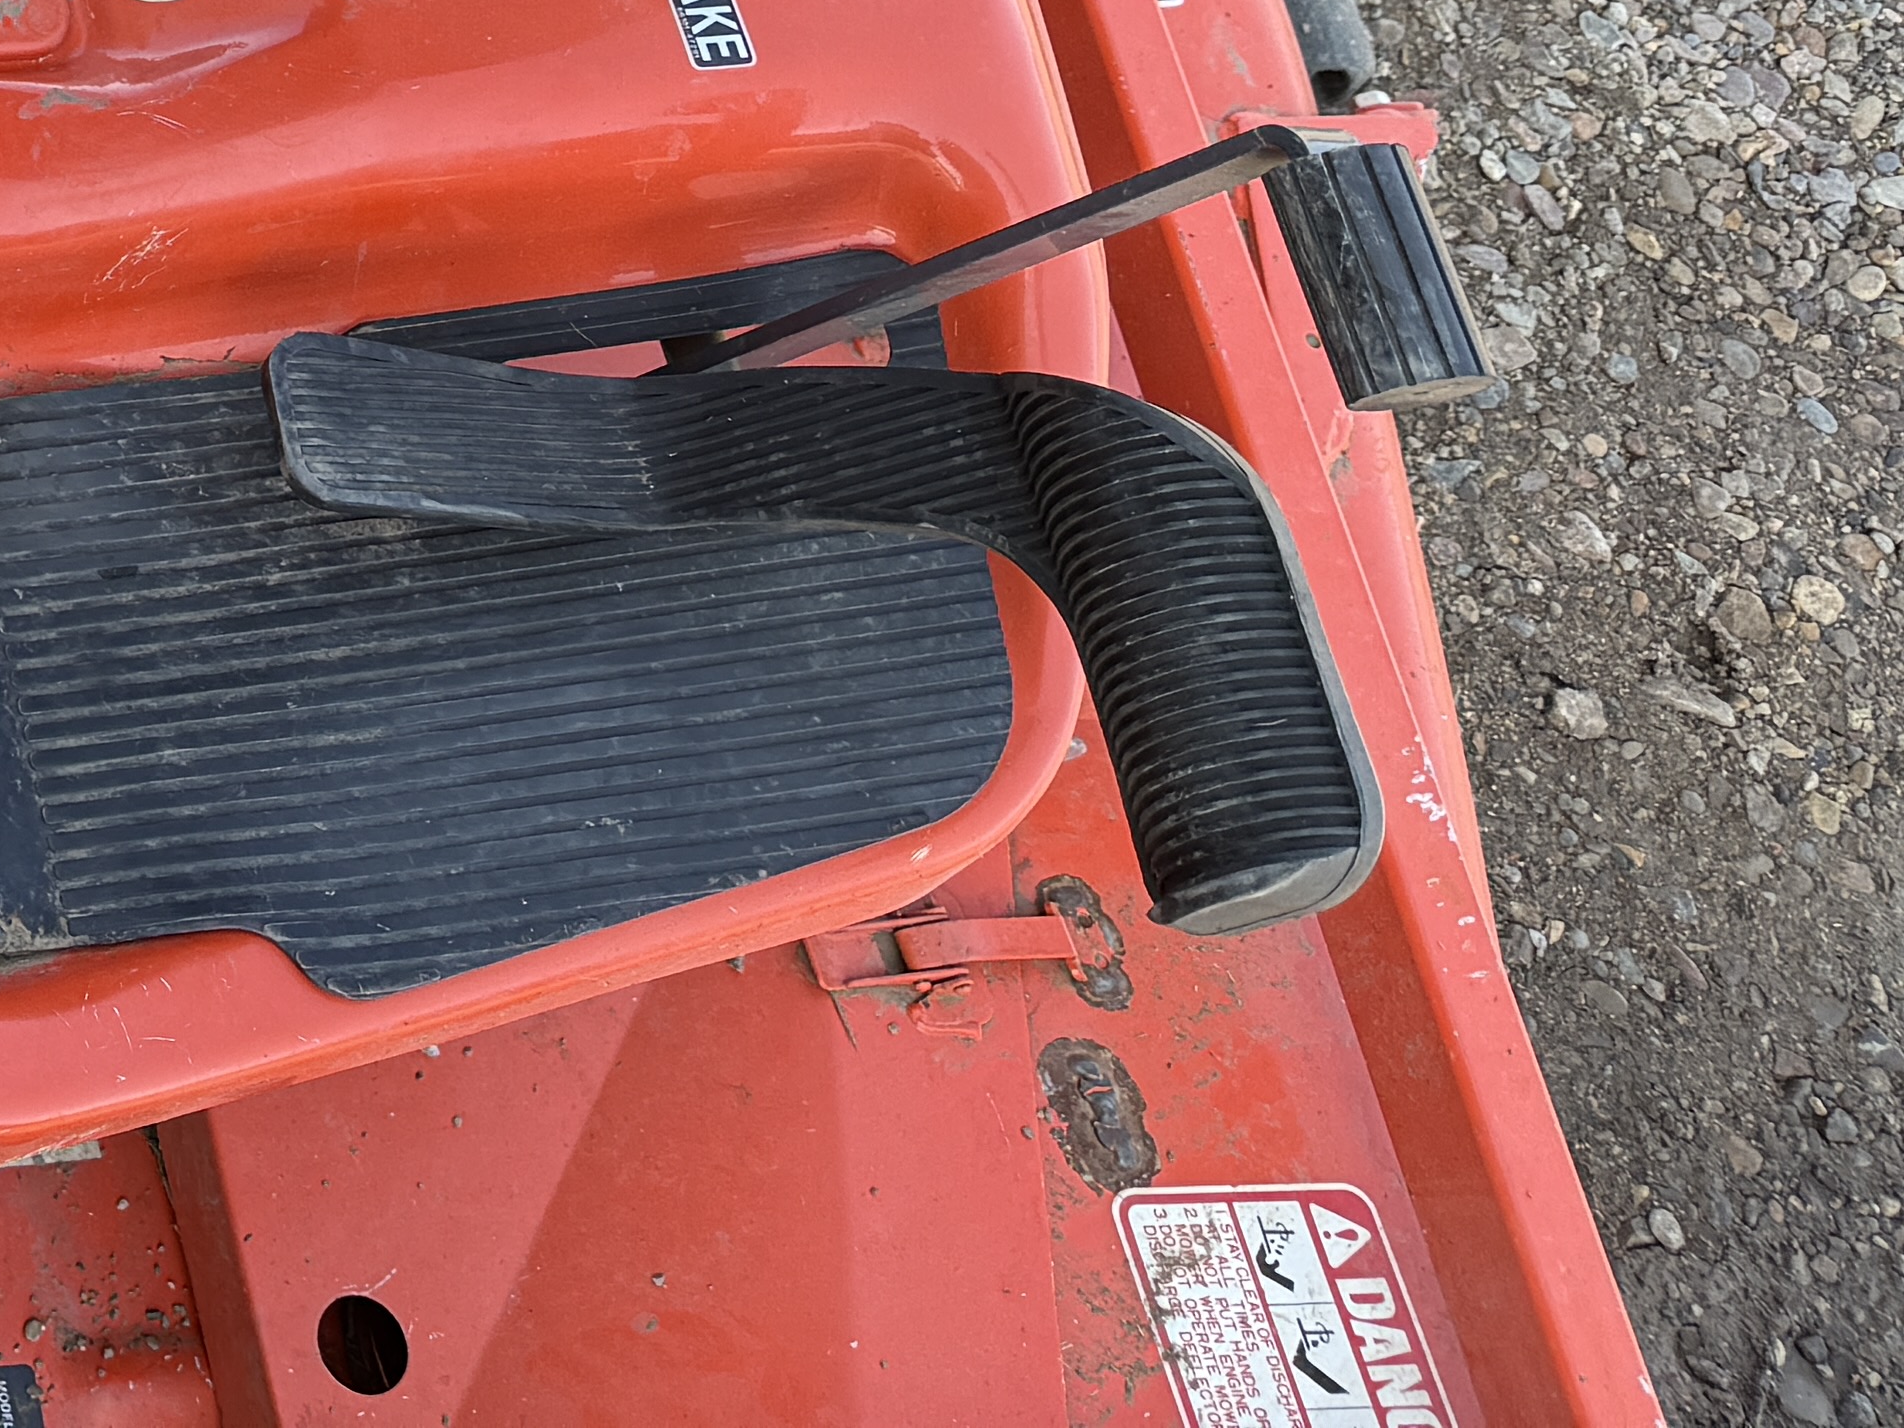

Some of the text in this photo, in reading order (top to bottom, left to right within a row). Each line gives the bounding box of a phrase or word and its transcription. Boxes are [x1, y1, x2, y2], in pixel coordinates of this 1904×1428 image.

[1157, 1224, 1177, 1247] DO
[1182, 1297, 1221, 1374] OPERATE
[1199, 1255, 1222, 1288] NOT
[1214, 1297, 1237, 1332] PUT
[1228, 1339, 1260, 1398] HANDS
[1214, 1254, 1237, 1288] ALL
[1218, 1222, 1244, 1262] STAY
[1234, 1266, 1265, 1324] CLEAR
[1255, 1327, 1275, 1351] OF
[1197, 1295, 1226, 1344] WHEN
[1217, 1354, 1251, 1417] ENGINE
